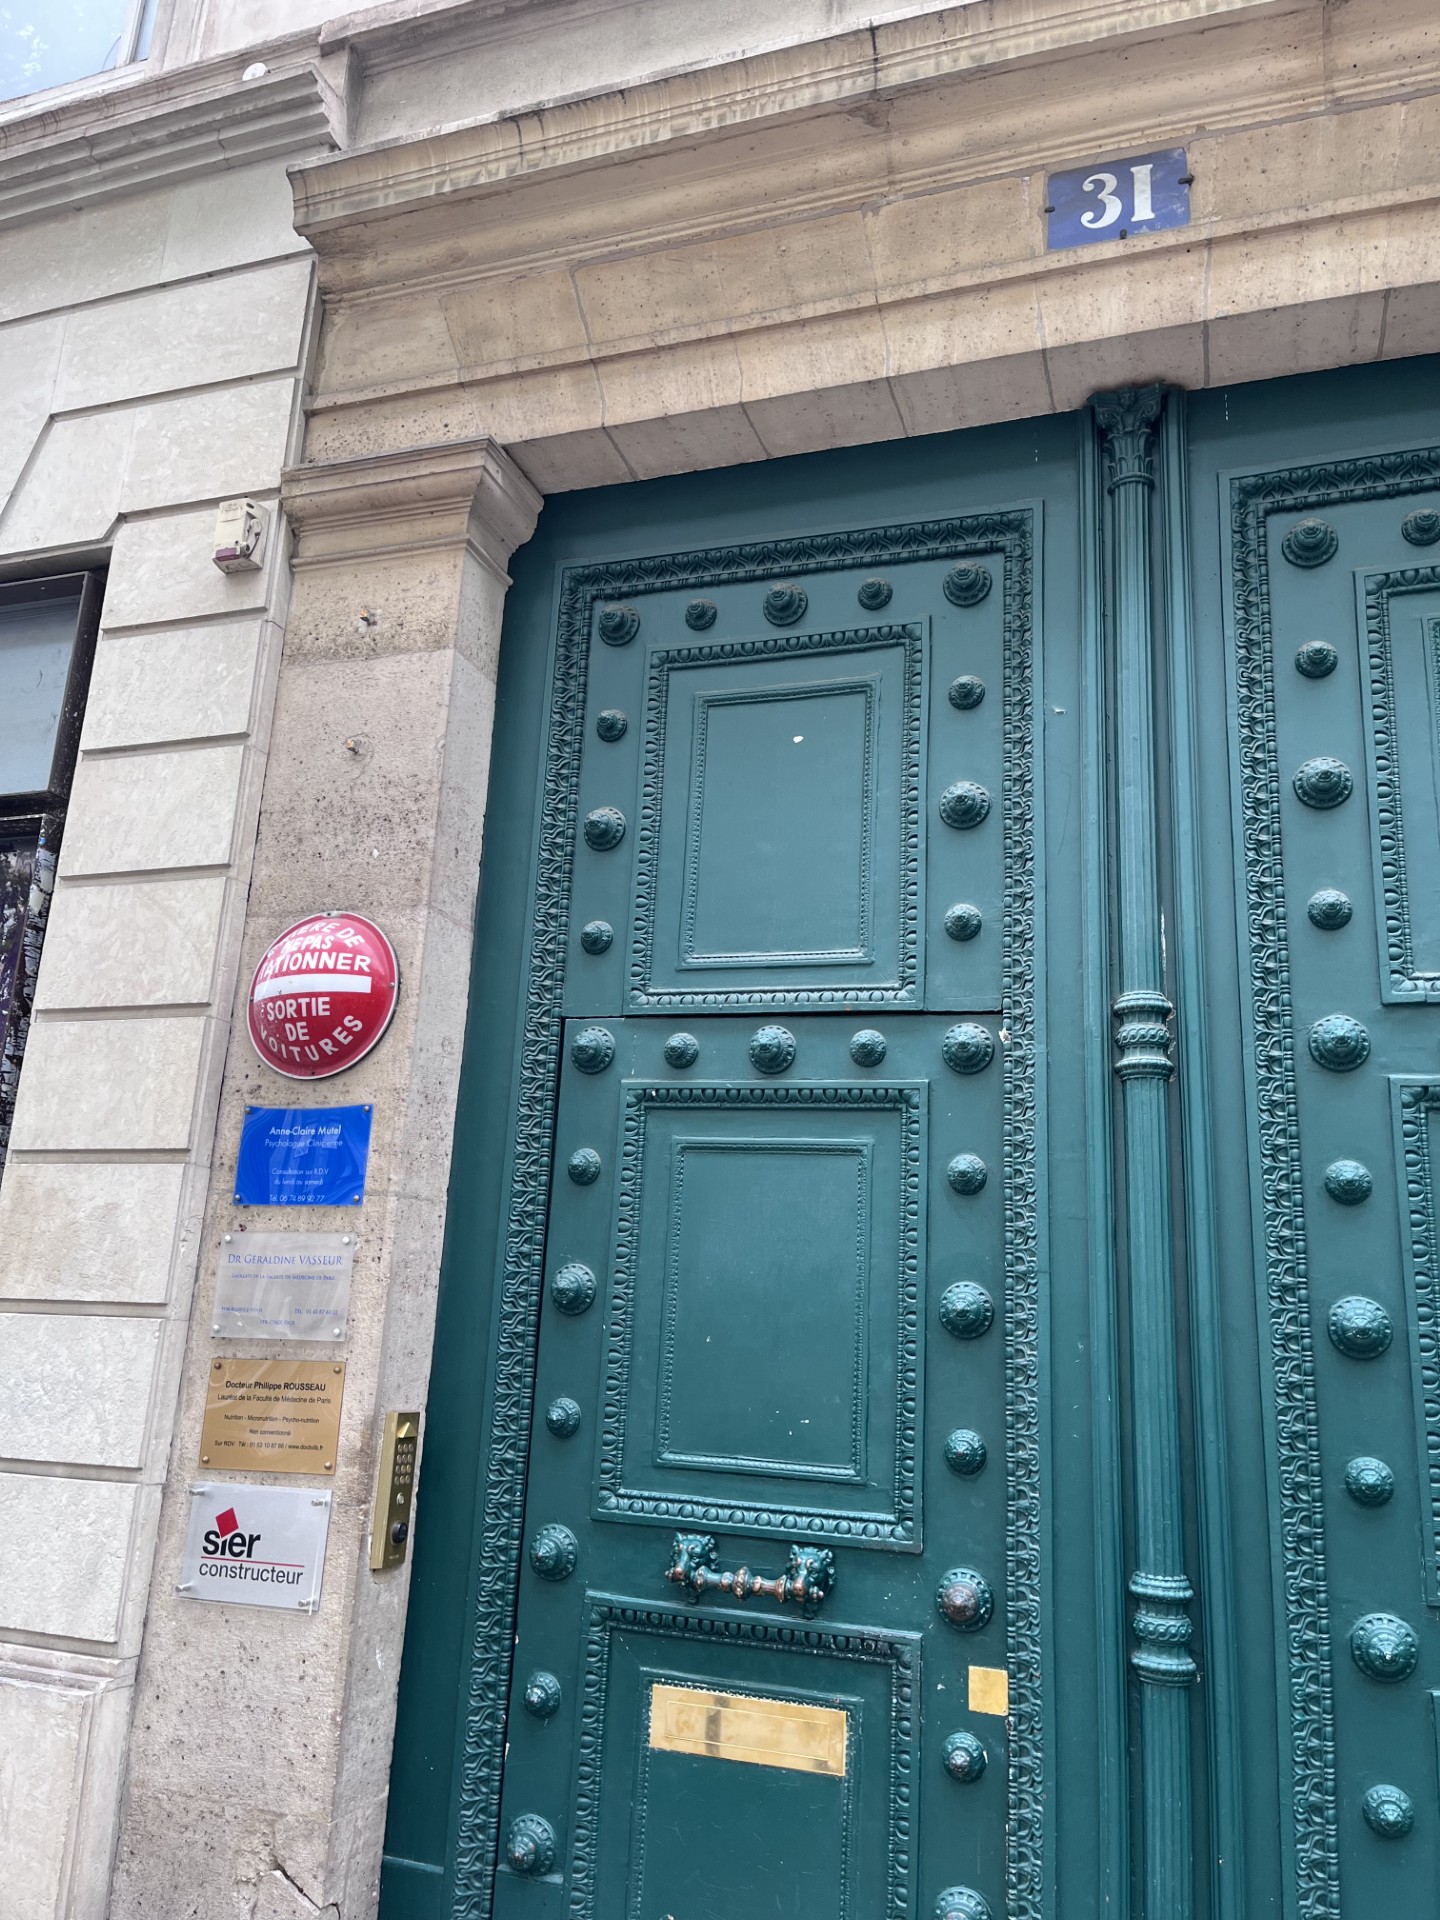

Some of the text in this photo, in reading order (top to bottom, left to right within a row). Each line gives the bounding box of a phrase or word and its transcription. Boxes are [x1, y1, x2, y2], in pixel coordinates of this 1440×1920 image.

[1080, 163, 1156, 231] 31
[335, 927, 366, 948] DE
[266, 996, 331, 1022] SORTIE
[260, 1015, 363, 1062] VOITURES
[284, 1021, 310, 1042] DE
[269, 1125, 341, 1135] Anne-Claire Mutel
[264, 1139, 305, 1149] Psychologue
[279, 1194, 288, 1202] 06
[316, 1194, 325, 1202] 77
[298, 1255, 343, 1266] VASSEUR
[226, 1380, 326, 1391] Docteur Philippe ROUSSEAU
[252, 1394, 272, 1402] Faculté
[281, 1395, 308, 1403] Médecine
[282, 1416, 320, 1424] Psycho-nutrition
[202, 1526, 261, 1558] sier
[199, 1564, 304, 1585] constructeur
